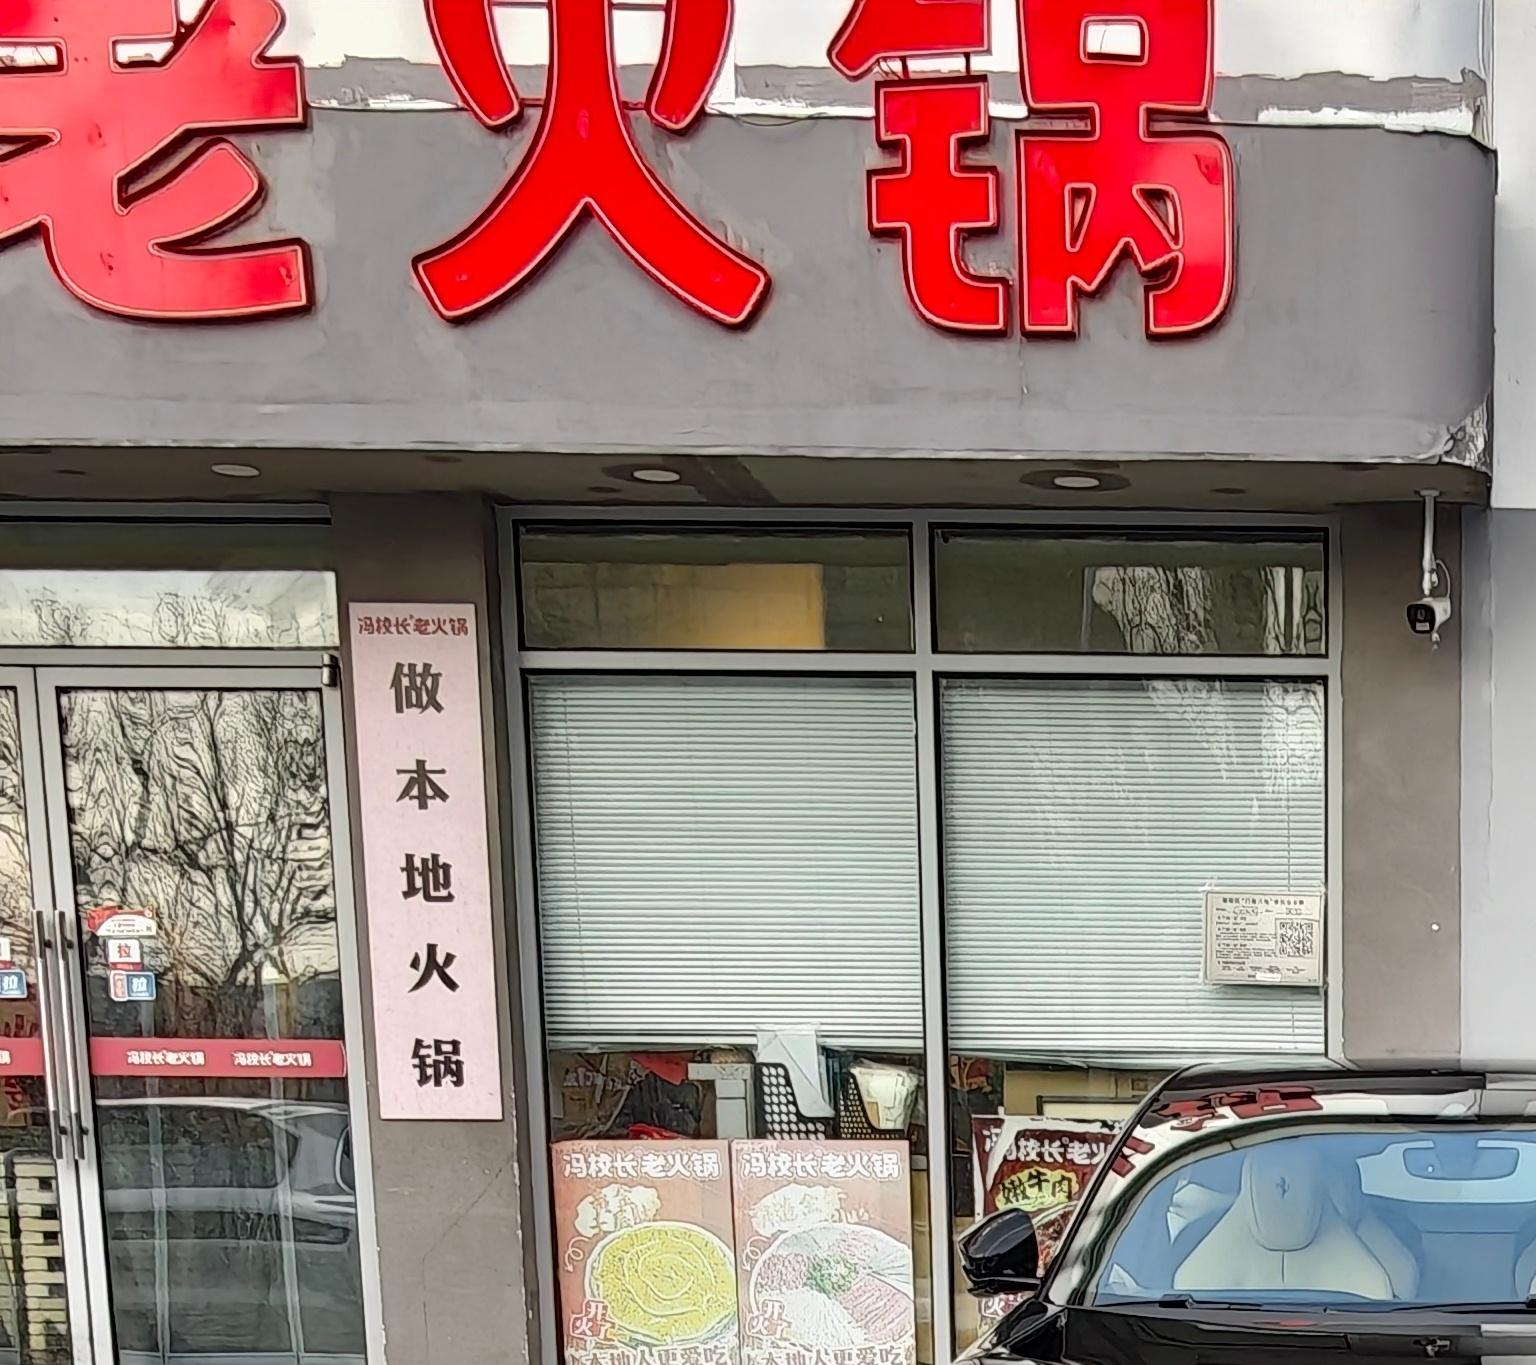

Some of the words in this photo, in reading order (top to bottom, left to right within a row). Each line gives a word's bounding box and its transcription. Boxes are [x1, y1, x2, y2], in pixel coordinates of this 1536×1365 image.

[357, 616, 468, 636] 冯校长老火锅
[390, 662, 464, 1087] 做本地火锅
[562, 1152, 722, 1179] 冯校长老火锅
[742, 1152, 902, 1179] 冯校长老火锅
